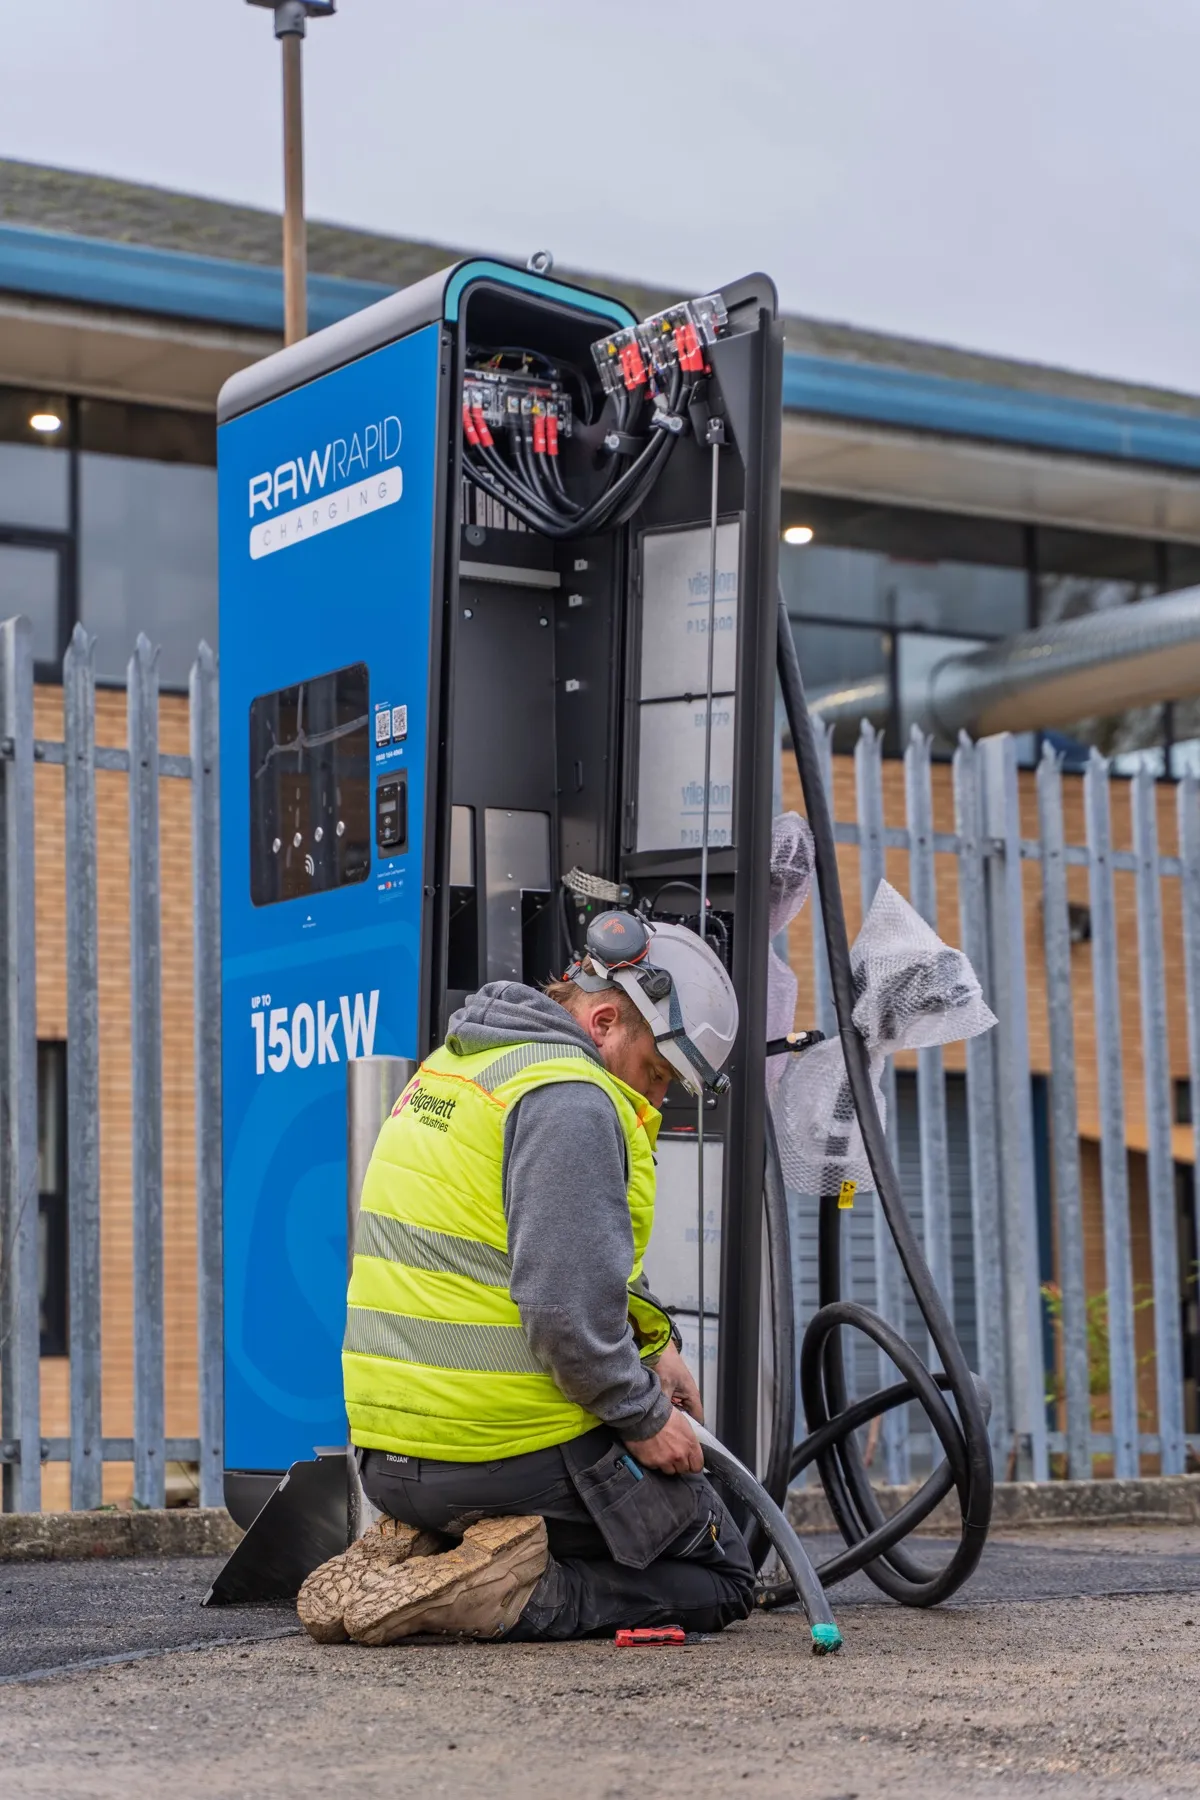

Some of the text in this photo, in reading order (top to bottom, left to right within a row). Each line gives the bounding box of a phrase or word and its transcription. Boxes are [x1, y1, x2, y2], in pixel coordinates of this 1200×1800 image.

[262, 482, 387, 547] CHARGING
[251, 994, 271, 1009] UP TO
[251, 989, 380, 1075] 150kW
[410, 1087, 457, 1120] Gigawatt
[419, 1113, 449, 1133] industries
[386, 1454, 408, 1464] TROJAN
